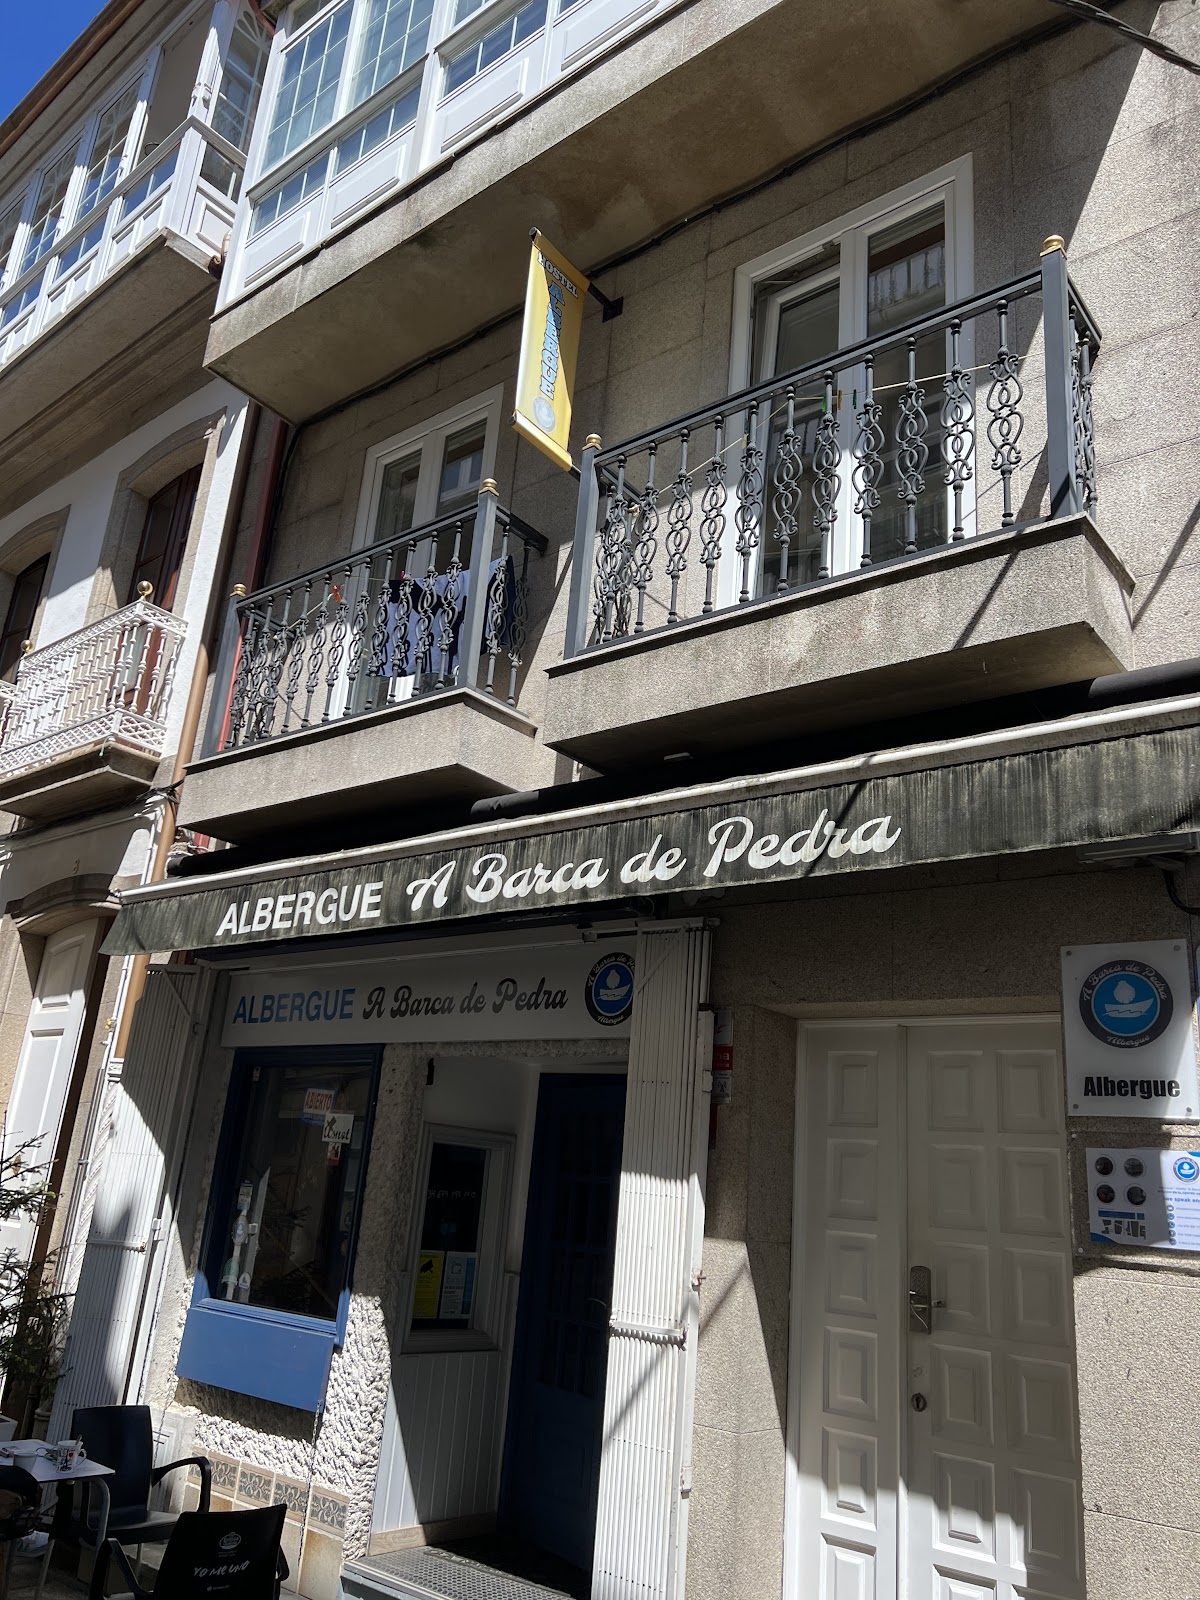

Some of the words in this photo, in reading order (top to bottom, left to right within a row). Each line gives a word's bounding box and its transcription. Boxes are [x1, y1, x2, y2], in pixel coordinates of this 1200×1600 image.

[537, 250, 578, 299] HOSTEL
[215, 881, 383, 936] ALBERGUE
[406, 860, 456, 912] A
[466, 853, 609, 902] Barca
[620, 834, 686, 885] de
[703, 808, 901, 877] Pedra
[593, 955, 616, 974] Barca
[617, 954, 627, 962] de
[1089, 964, 1121, 985] Barca
[1126, 962, 1140, 972] de
[1142, 967, 1168, 1000] Pedra
[232, 988, 356, 1024] ALBERGUE
[362, 986, 385, 1020] A
[390, 985, 455, 1018] Barca
[459, 982, 486, 1013] de
[492, 977, 568, 1013] Pedra
[1107, 1035, 1150, 1047] Albergue
[1084, 1076, 1181, 1099] Albergue
[304, 1091, 333, 1111] ABIERTO
[194, 1567, 209, 1577] YO
